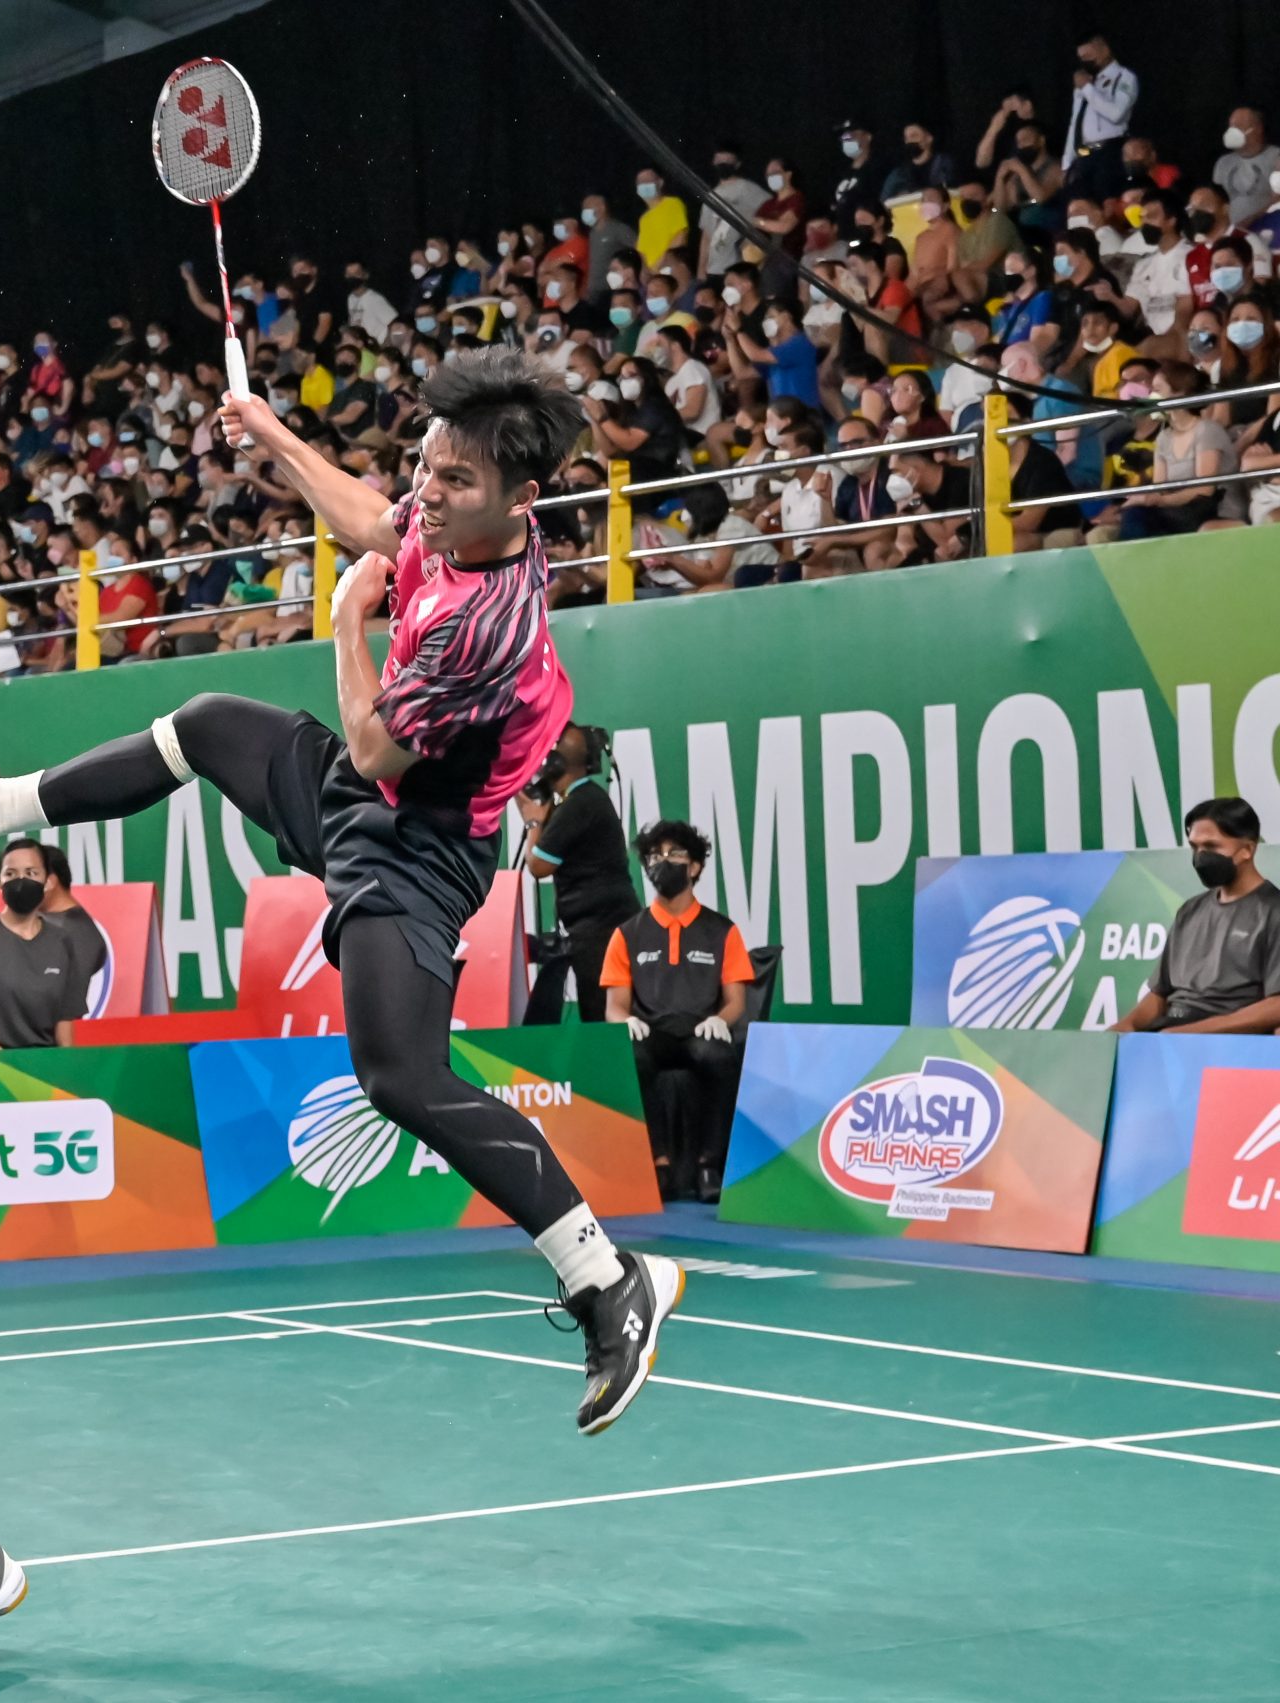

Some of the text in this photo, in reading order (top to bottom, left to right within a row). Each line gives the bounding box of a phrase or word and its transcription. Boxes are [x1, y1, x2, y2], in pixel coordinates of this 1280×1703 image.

[1100, 922, 1167, 961] BAD
[483, 1081, 572, 1108] INTON
[849, 1091, 976, 1138] SMASH
[32, 1129, 99, 1177] 5G
[847, 1141, 962, 1169] PILIPINAS
[894, 1203, 948, 1217] Association
[895, 1188, 992, 1207] Philippine Badminton
